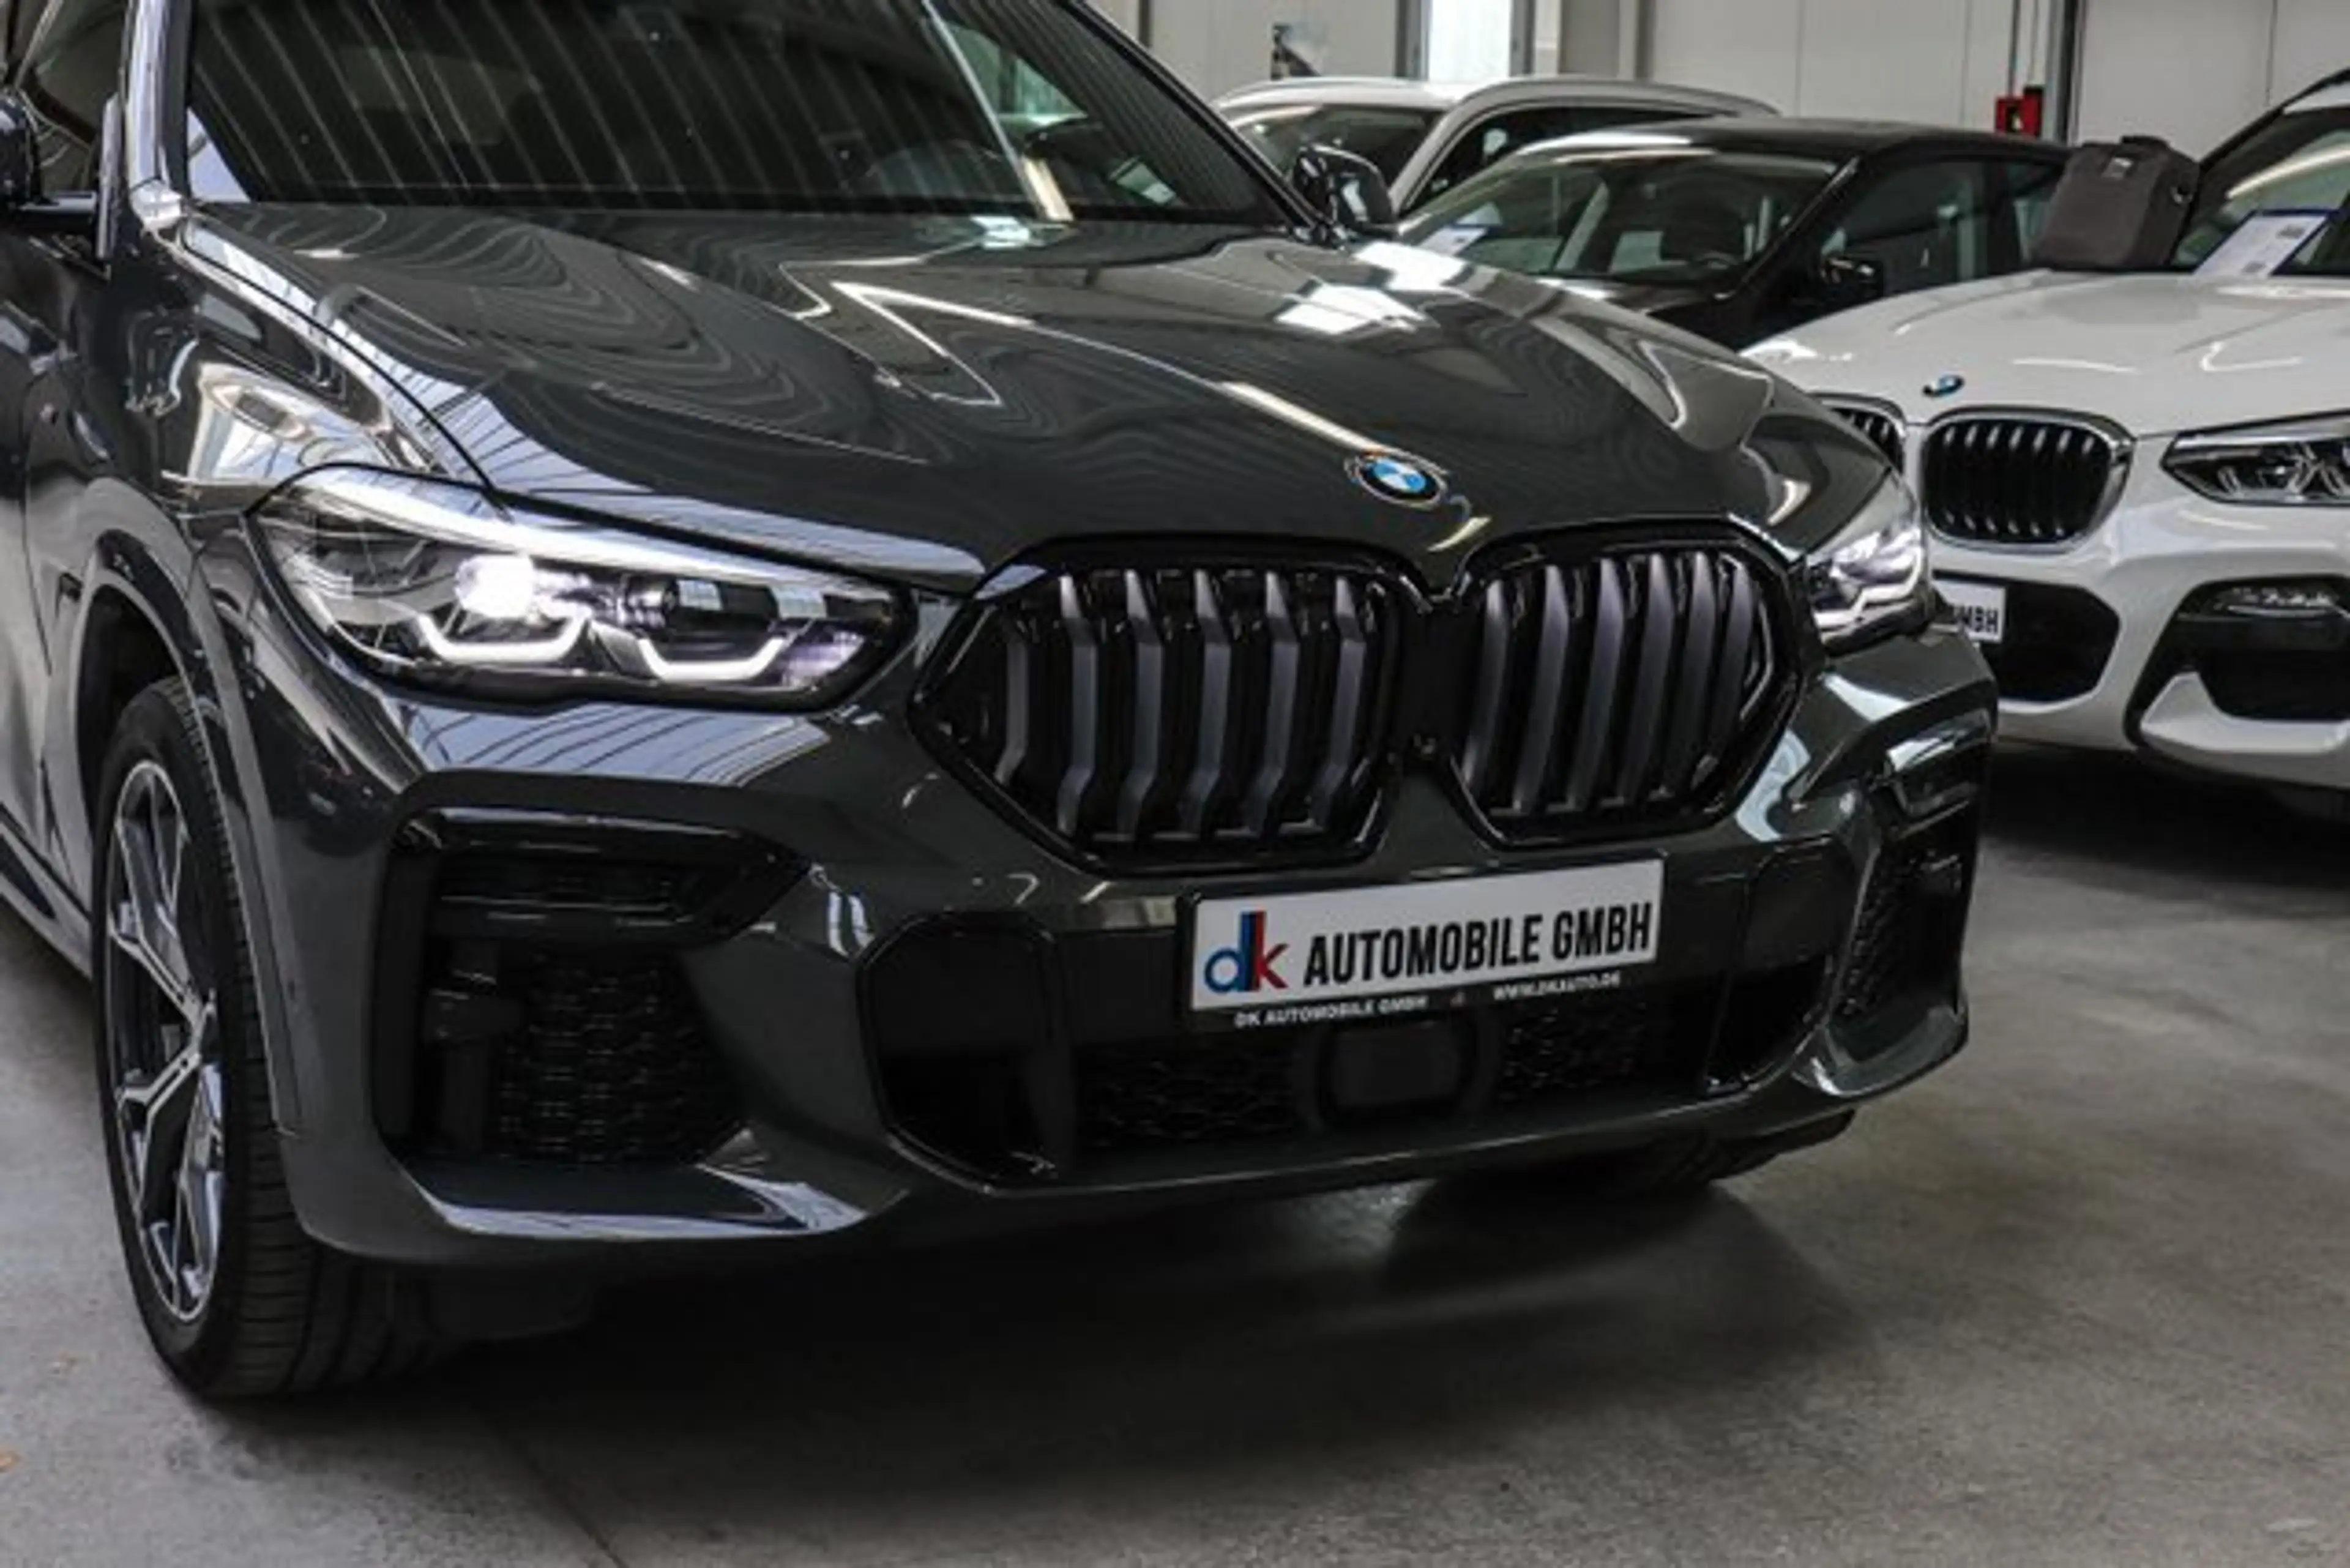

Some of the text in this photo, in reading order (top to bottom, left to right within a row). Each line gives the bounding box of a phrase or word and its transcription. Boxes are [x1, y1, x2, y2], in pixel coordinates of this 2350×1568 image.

[1204, 902, 1652, 995] dk AUTOMOBILE GMBH
[1234, 1012, 1261, 1029] DK
[1264, 999, 1375, 1026] AUTOMOBILE
[1378, 995, 1430, 1014] GMBH
